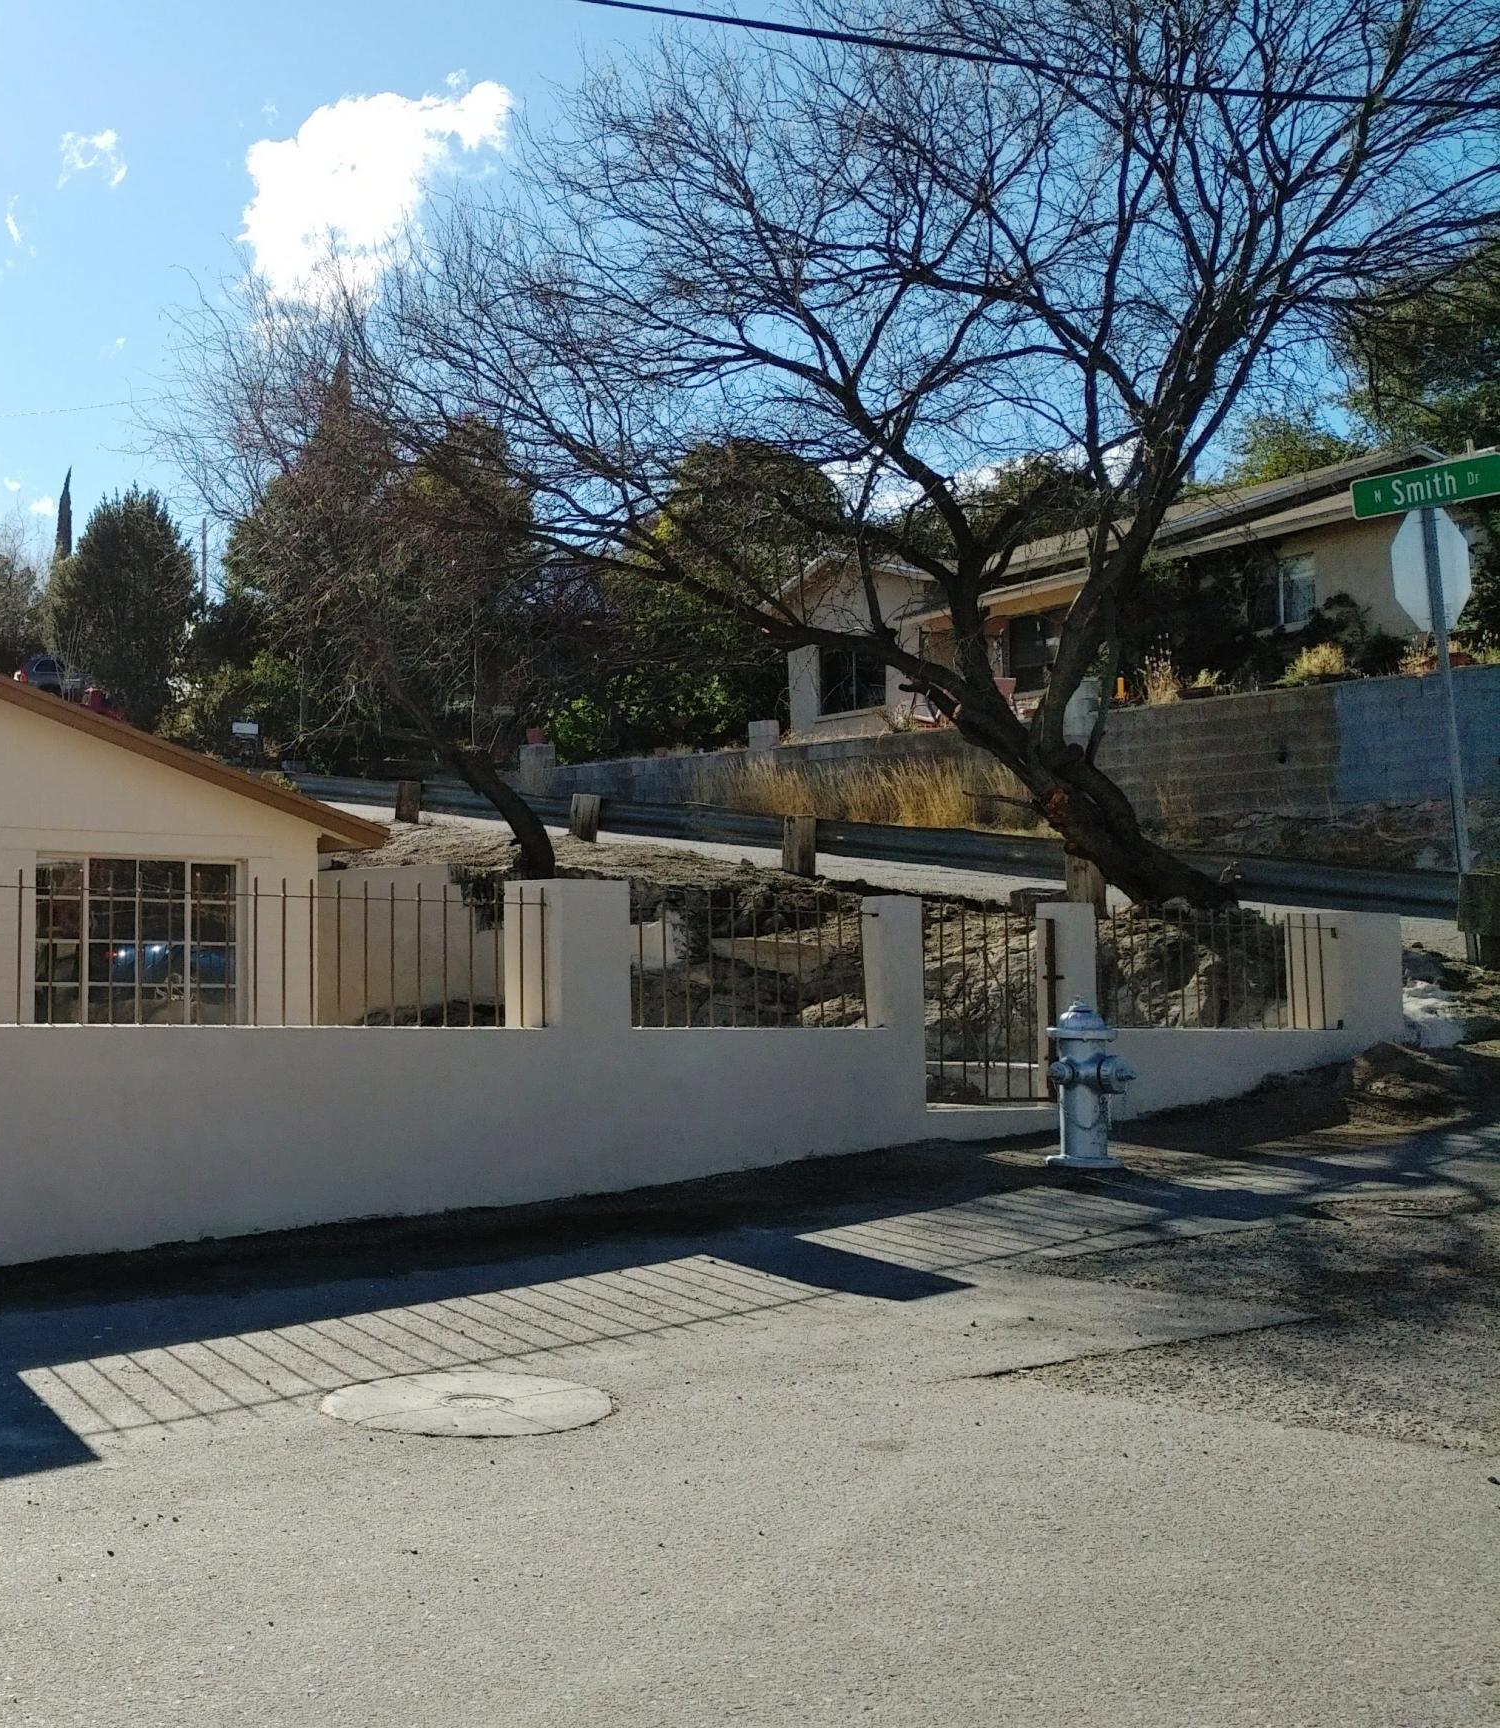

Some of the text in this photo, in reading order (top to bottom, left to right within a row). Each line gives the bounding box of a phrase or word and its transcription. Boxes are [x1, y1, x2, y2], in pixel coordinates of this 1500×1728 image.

[1373, 471, 1481, 505] N Smith Dr
